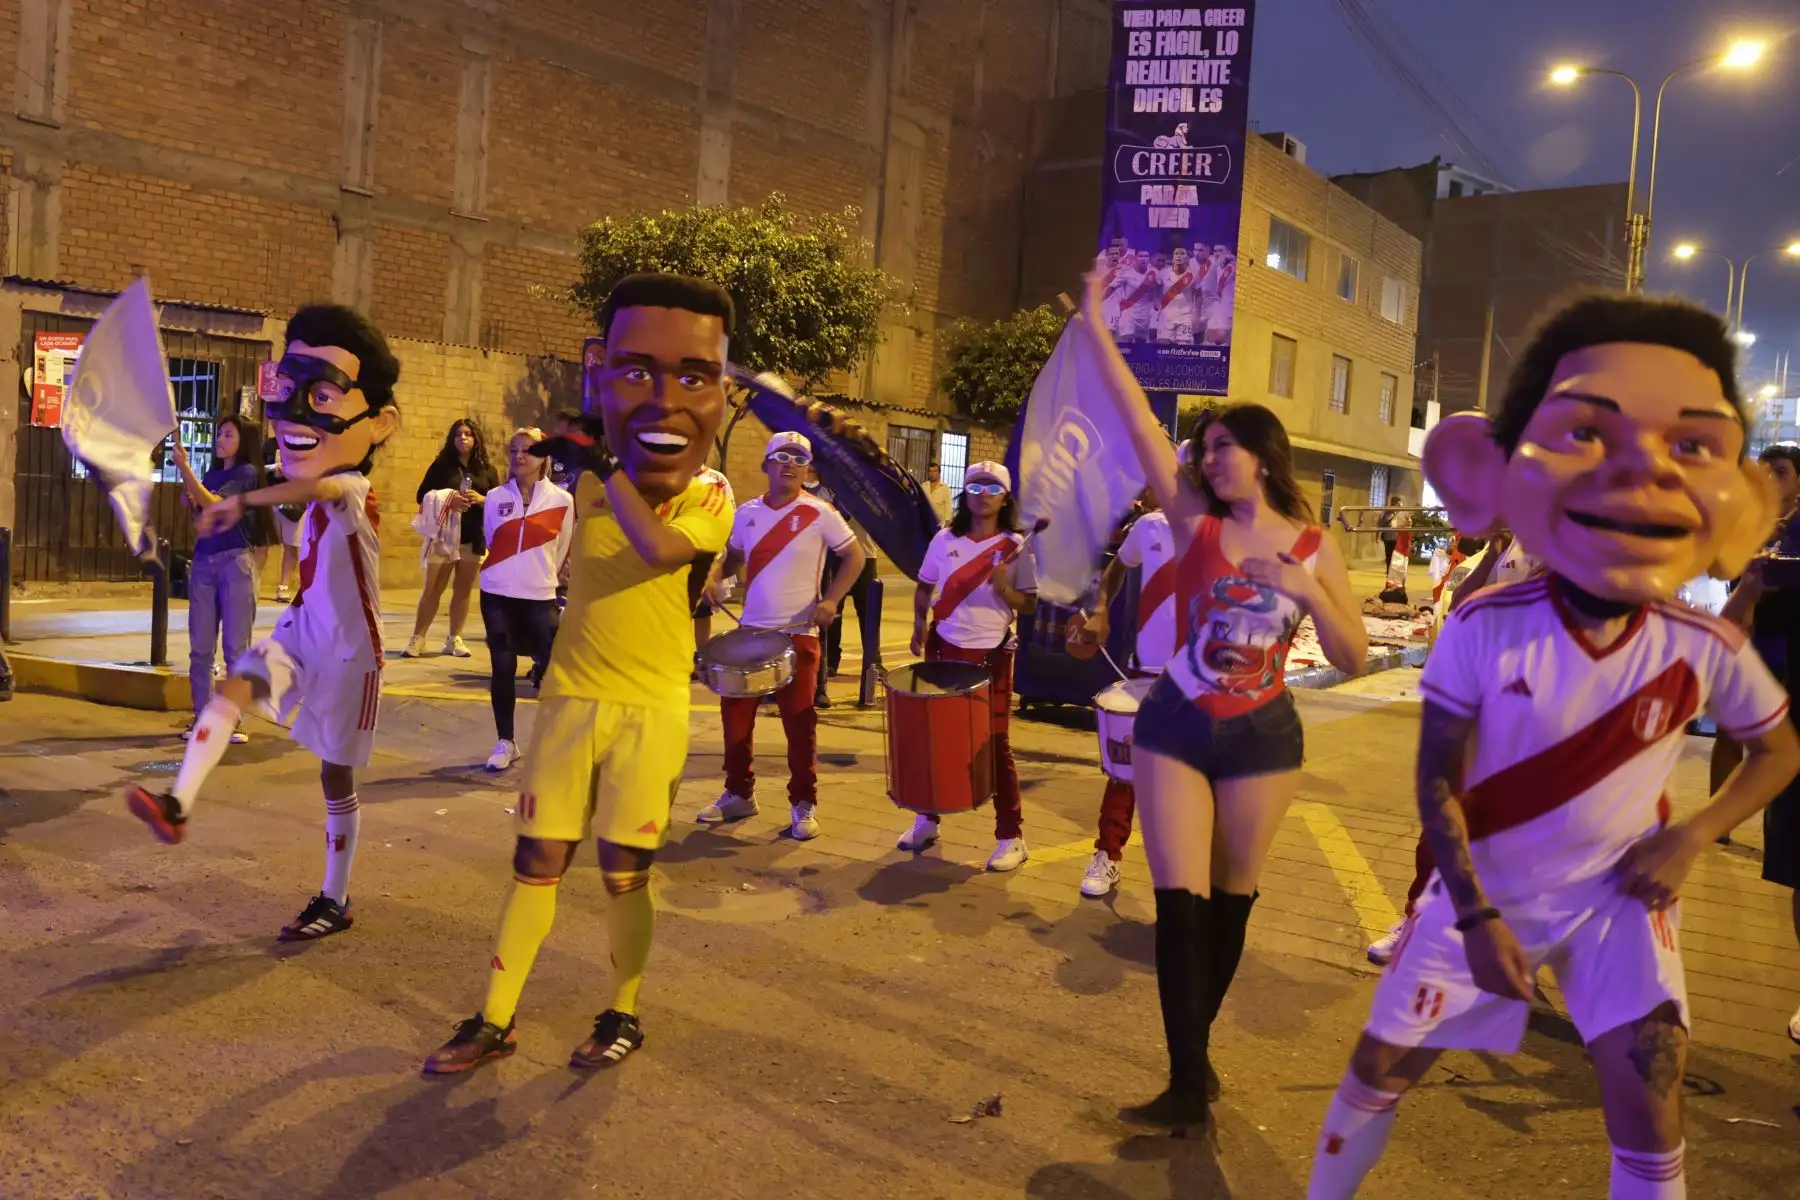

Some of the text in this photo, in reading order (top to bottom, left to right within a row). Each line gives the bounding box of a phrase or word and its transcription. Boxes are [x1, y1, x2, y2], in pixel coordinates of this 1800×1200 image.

[1204, 8, 1246, 27] CREER
[1128, 28, 1239, 58] ES FÁCIL, LO
[1125, 59, 1231, 85] REALMENTE
[1198, 87, 1223, 113] ES
[1131, 151, 1212, 176] CREER
[1140, 184, 1199, 206] PARA
[1127, 361, 1162, 375] EBIDAS
